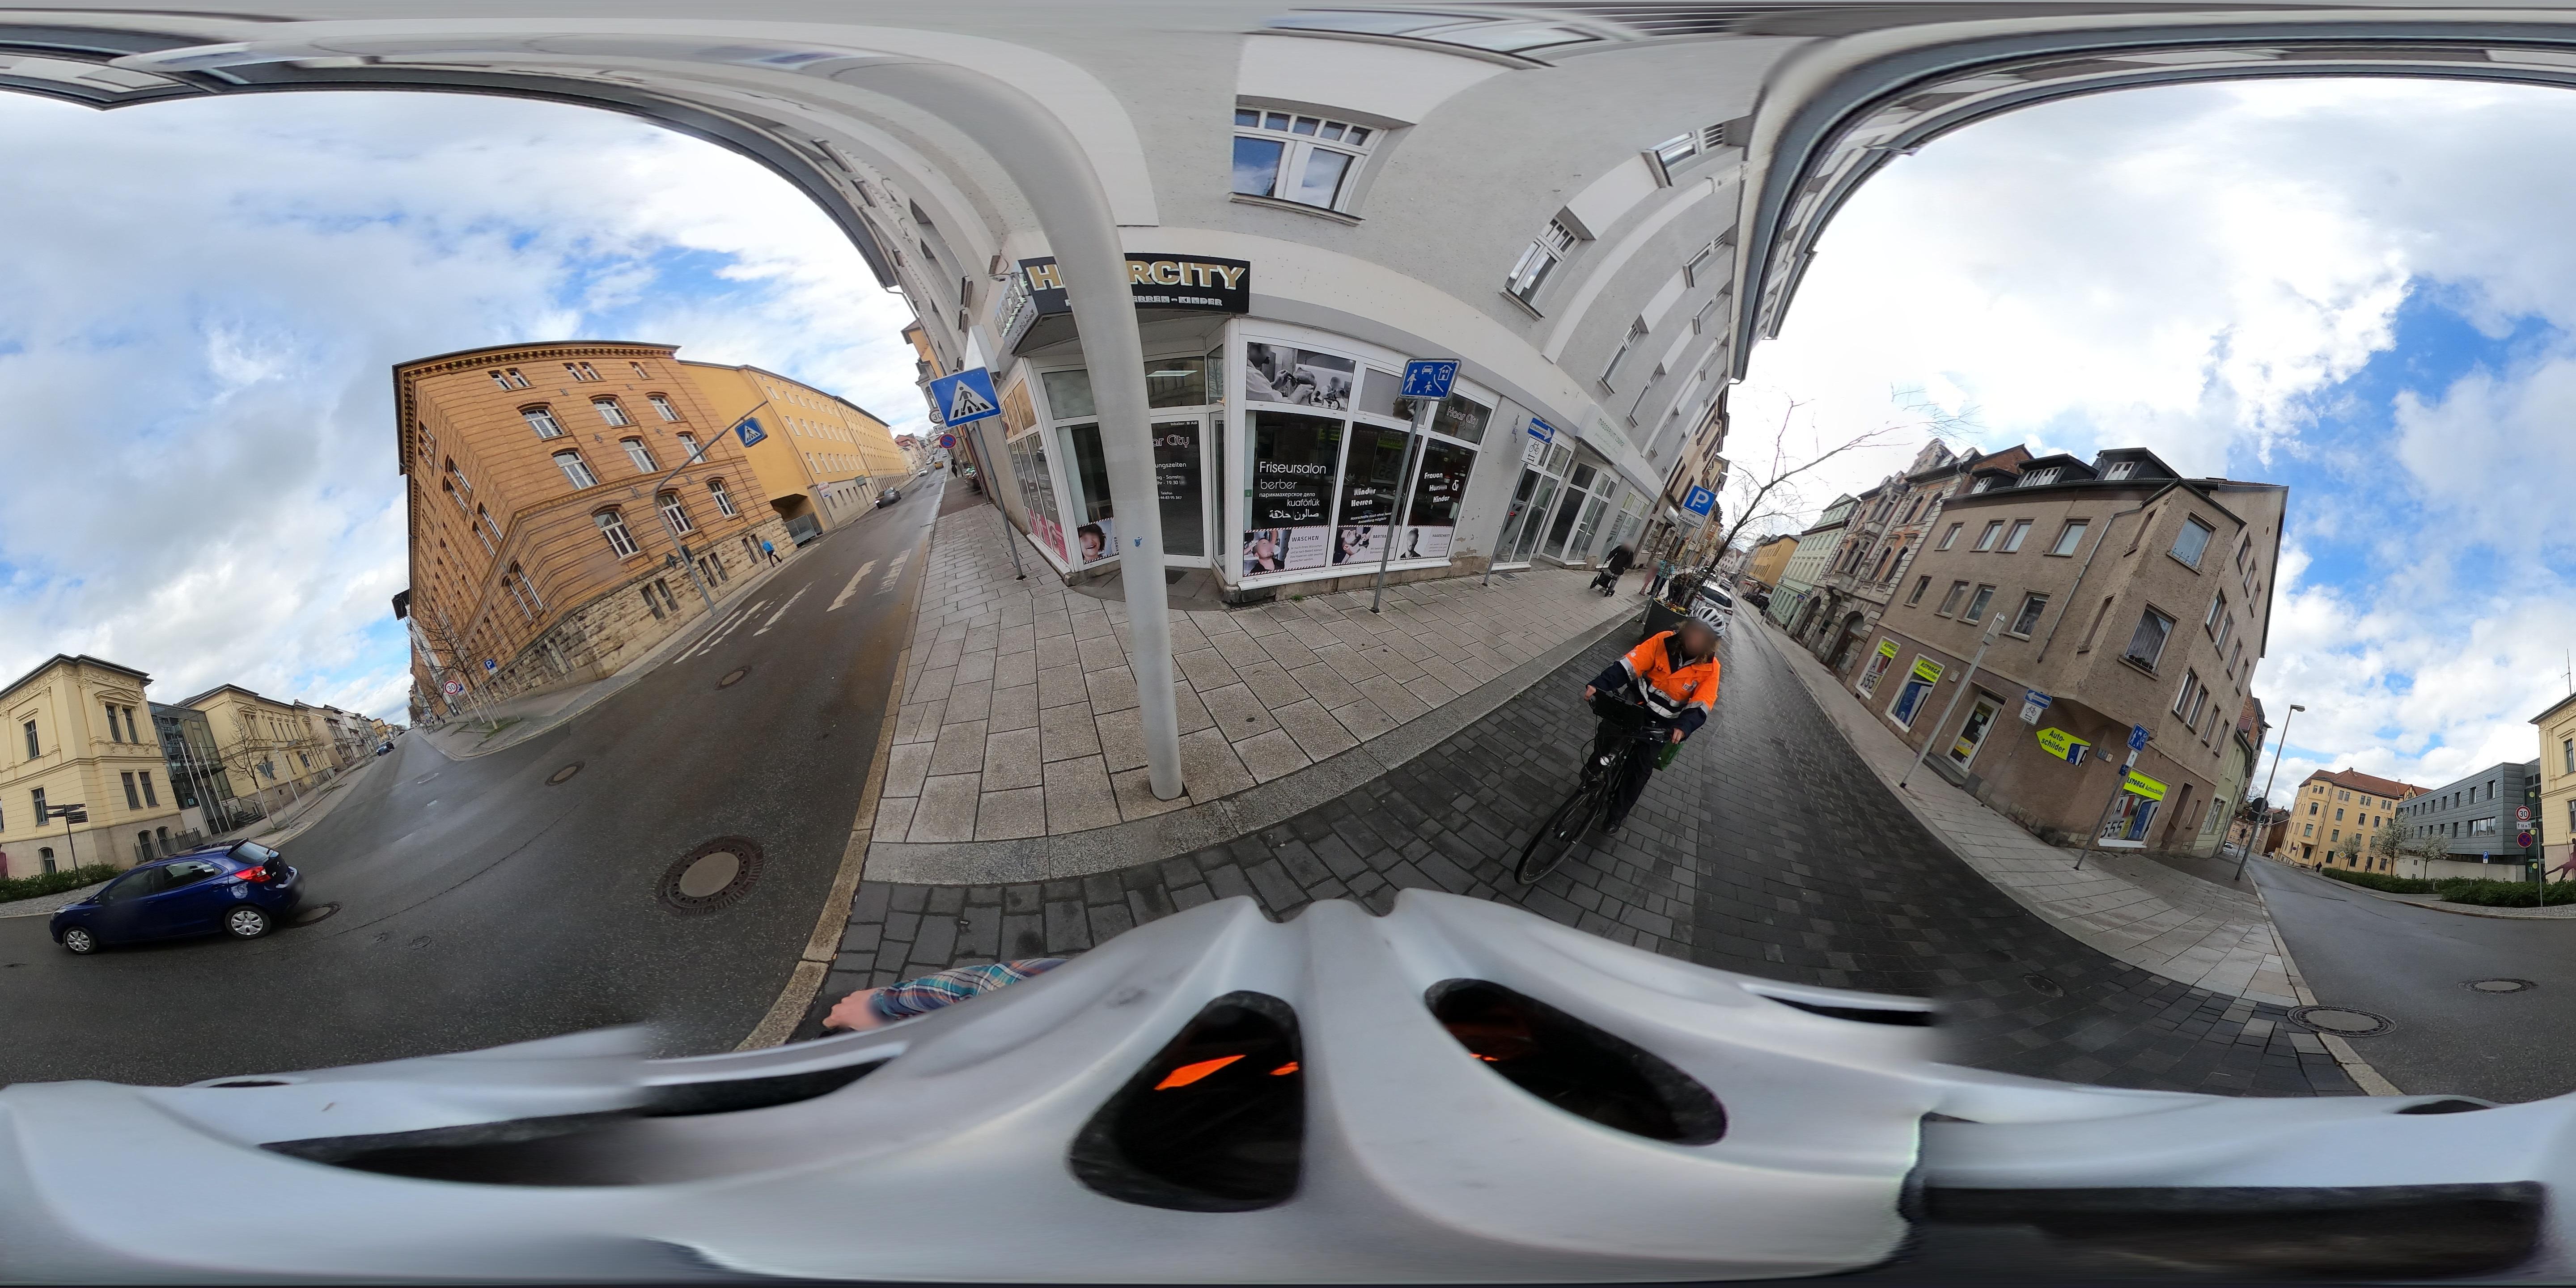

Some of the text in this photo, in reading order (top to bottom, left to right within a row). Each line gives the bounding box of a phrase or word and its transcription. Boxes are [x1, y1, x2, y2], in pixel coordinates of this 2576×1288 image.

[1026, 260, 1246, 291] HRCITY
[1133, 295, 1170, 303] ERREN
[1178, 297, 1223, 306] KINDER
[932, 412, 942, 420] 30
[1447, 406, 1466, 420] Haar
[1152, 434, 1190, 448] ar City
[1155, 462, 1187, 470] ungszeiten
[1259, 462, 1326, 474] Friseursalon
[1260, 479, 1298, 490] berber
[1354, 487, 1376, 496] indr
[1287, 498, 1320, 507] kuaförlük
[1351, 499, 1373, 507] Herren
[1433, 495, 1450, 503] Kinder
[1690, 490, 1709, 507] P
[1269, 508, 1319, 521] صالون حلاقة
[1679, 514, 1700, 527] Parkschein
[485, 661, 492, 669] P
[447, 684, 456, 692] 30
[2049, 730, 2065, 741] Auto-
[2041, 738, 2066, 754] schilder
